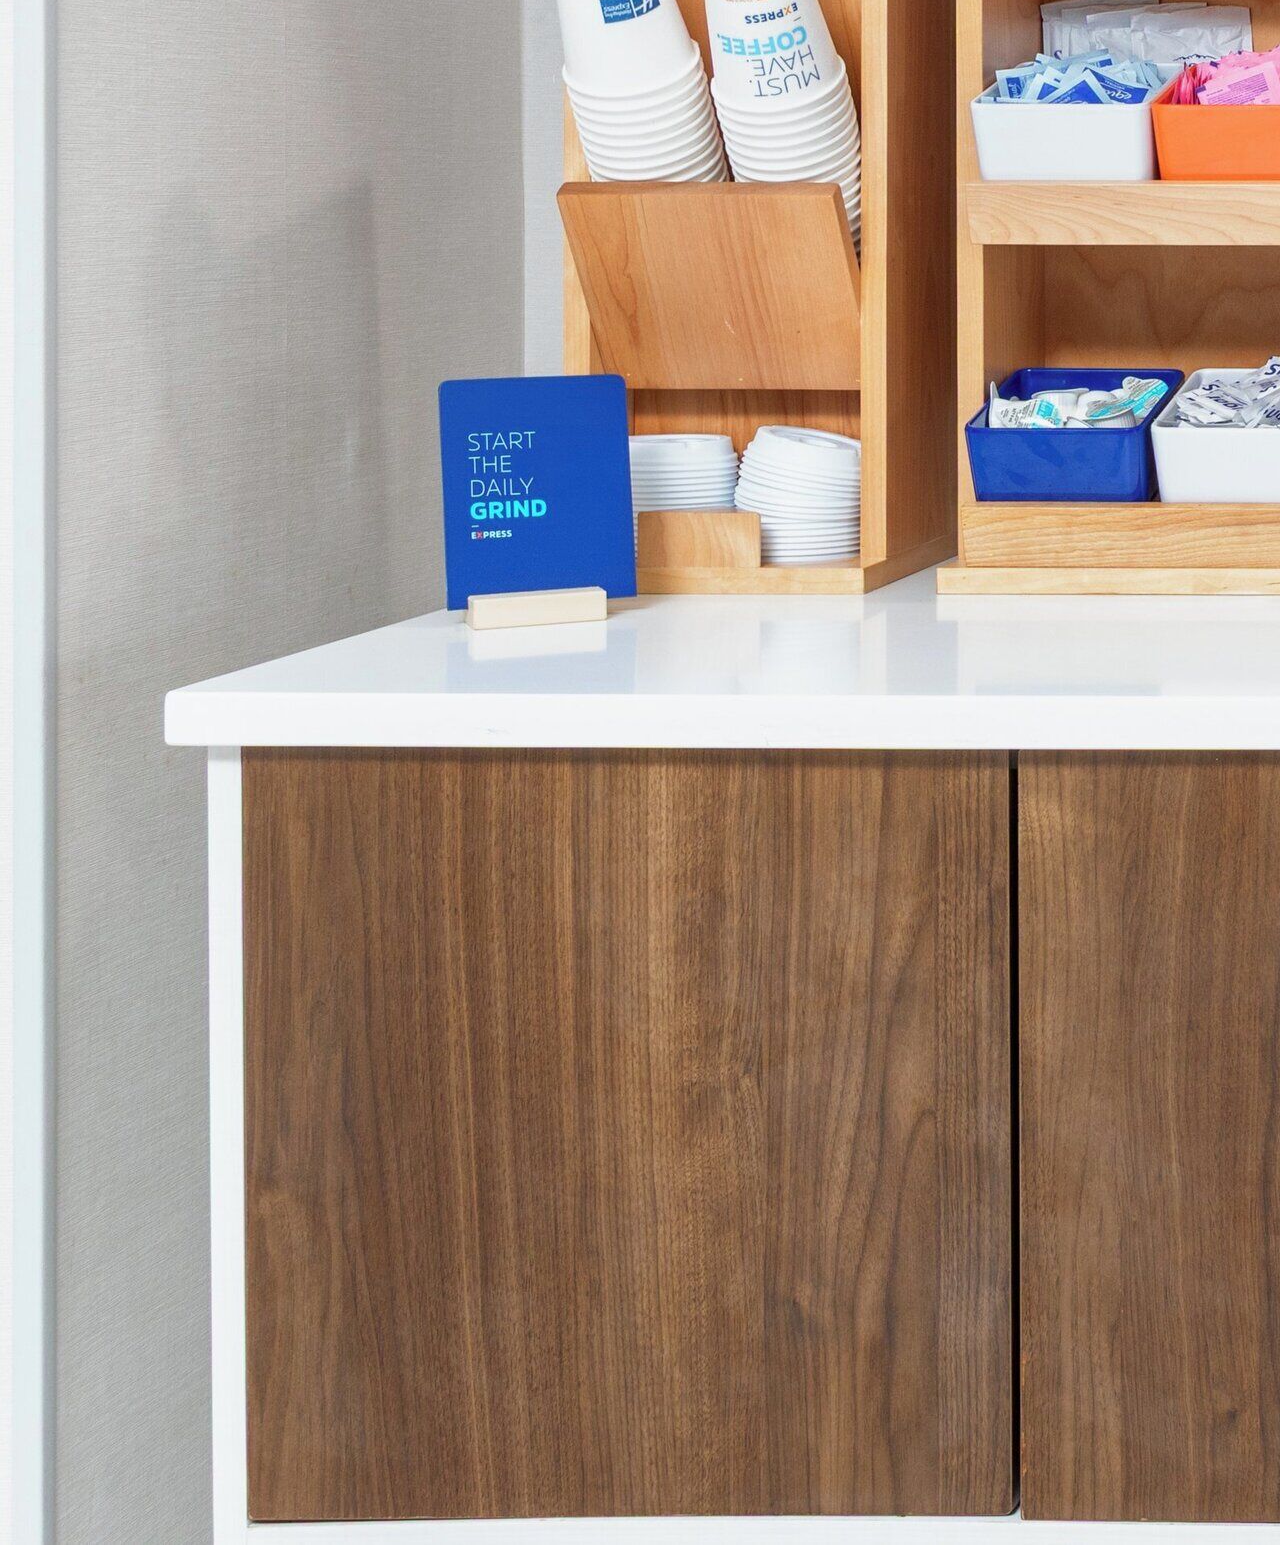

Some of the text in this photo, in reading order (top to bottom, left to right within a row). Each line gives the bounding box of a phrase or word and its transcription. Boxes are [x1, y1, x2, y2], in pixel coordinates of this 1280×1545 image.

[744, 2, 798, 25] EXPRESS
[717, 25, 808, 56] COFFEE.
[746, 44, 815, 77] HAVE.
[748, 64, 821, 98] MUST.
[468, 431, 536, 452] START
[468, 454, 512, 474] THE
[470, 477, 534, 498] DAILY
[470, 499, 547, 521] GRIND
[471, 529, 513, 540] EXPRESS
